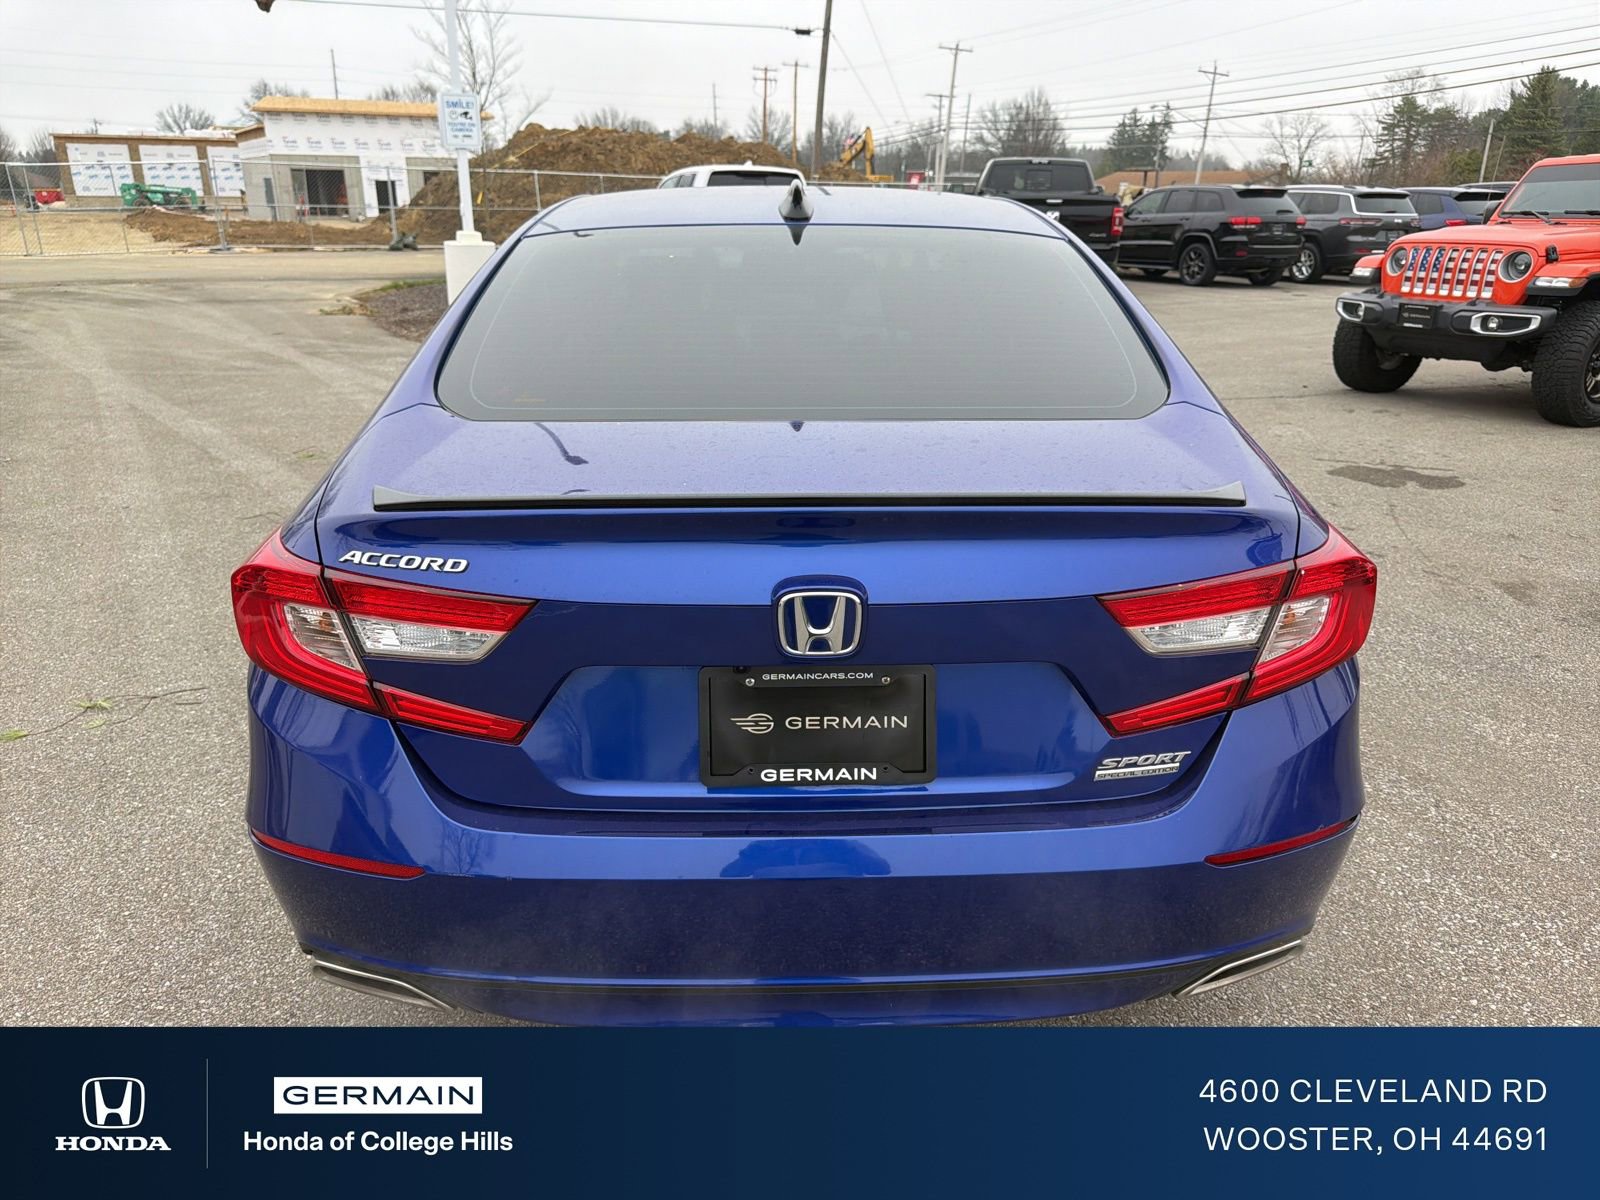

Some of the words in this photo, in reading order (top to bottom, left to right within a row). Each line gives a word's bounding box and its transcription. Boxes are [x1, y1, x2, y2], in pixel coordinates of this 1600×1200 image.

[338, 550, 468, 573] ACCORD
[762, 672, 874, 681] GERMAINCARS.COM
[785, 715, 908, 730] GERMAIN
[1097, 751, 1192, 769] SPORT
[760, 767, 877, 783] GERMAIN
[1097, 770, 1139, 779] SPECIAL
[1141, 766, 1179, 776] EDITION
